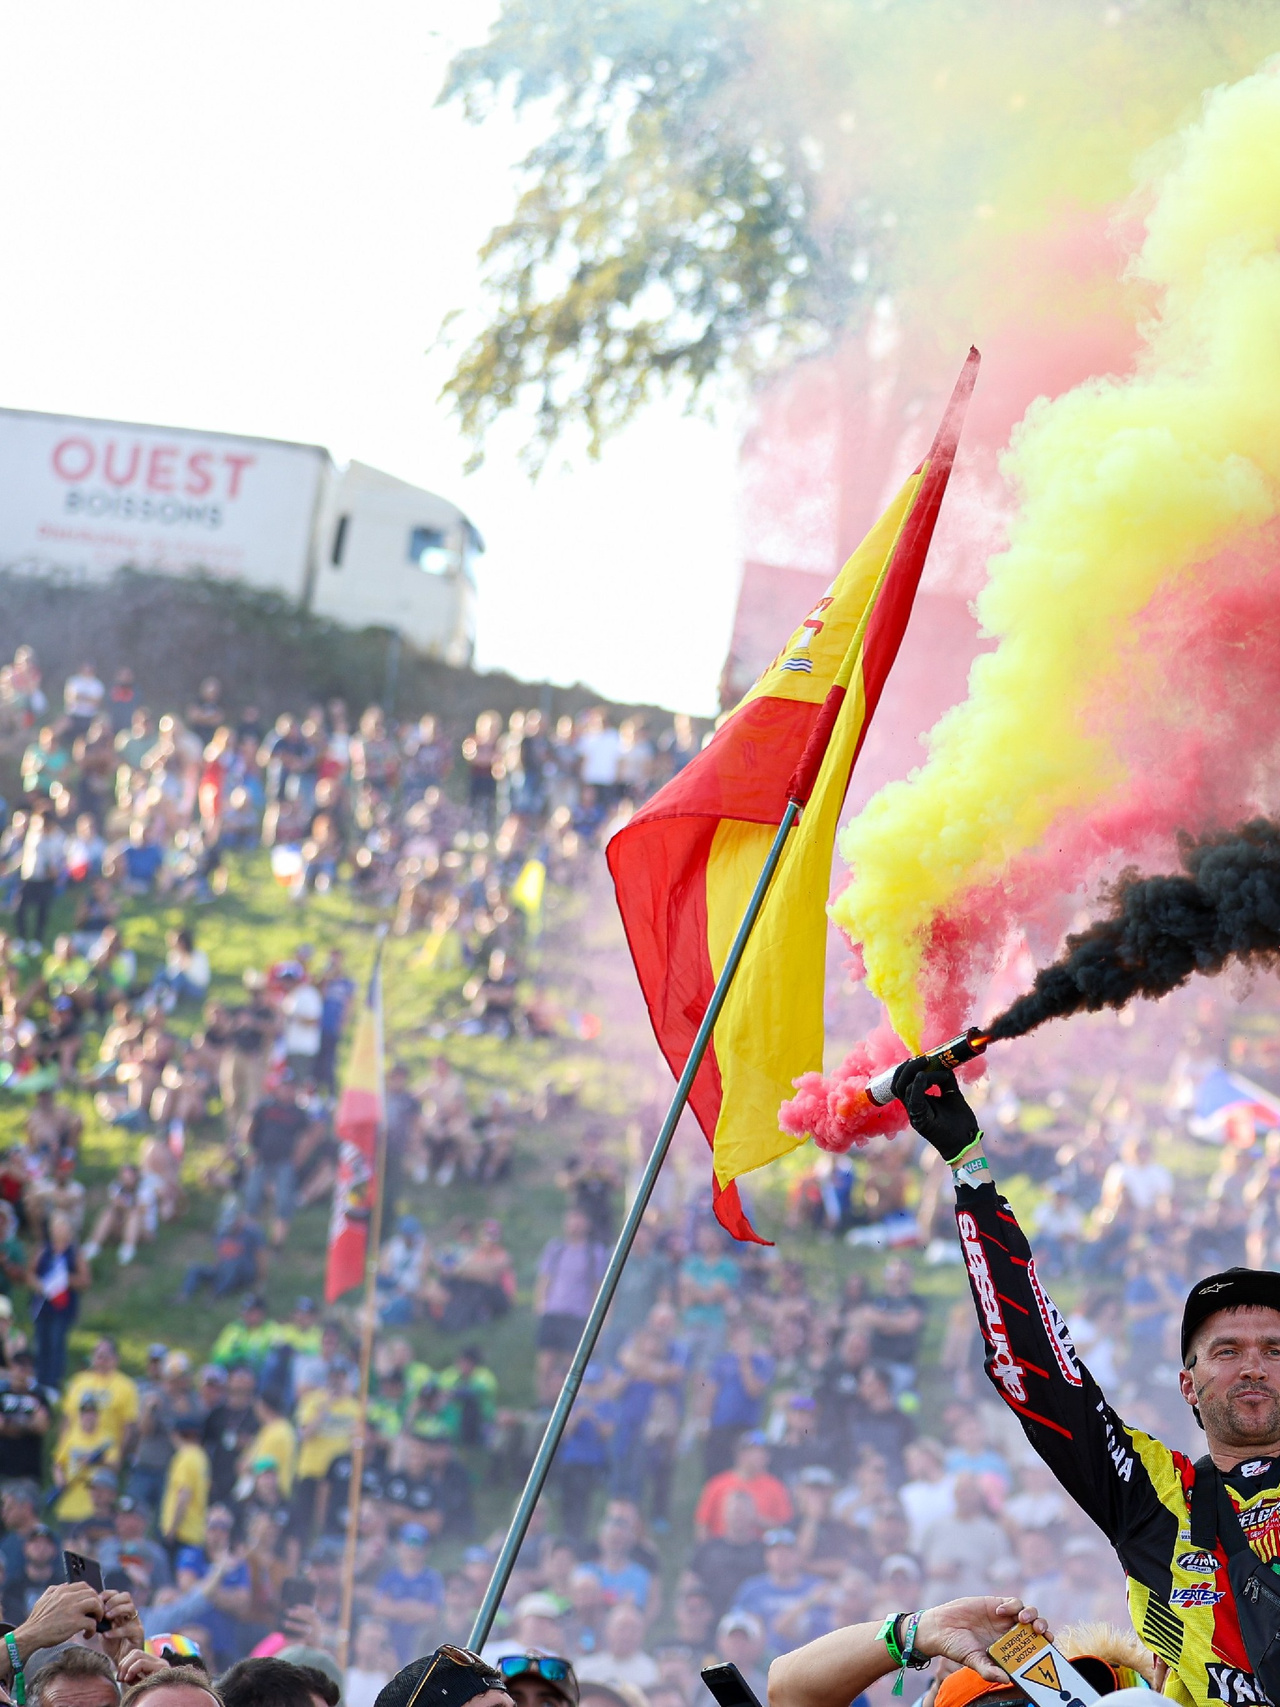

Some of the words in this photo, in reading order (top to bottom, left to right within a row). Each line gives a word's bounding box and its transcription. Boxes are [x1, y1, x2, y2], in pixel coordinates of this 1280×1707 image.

[50, 437, 257, 500] OUEST
[66, 488, 222, 531] BOISSONS
[1171, 1588, 1226, 1604] VERTEX
[1015, 1643, 1037, 1663] POZOR
